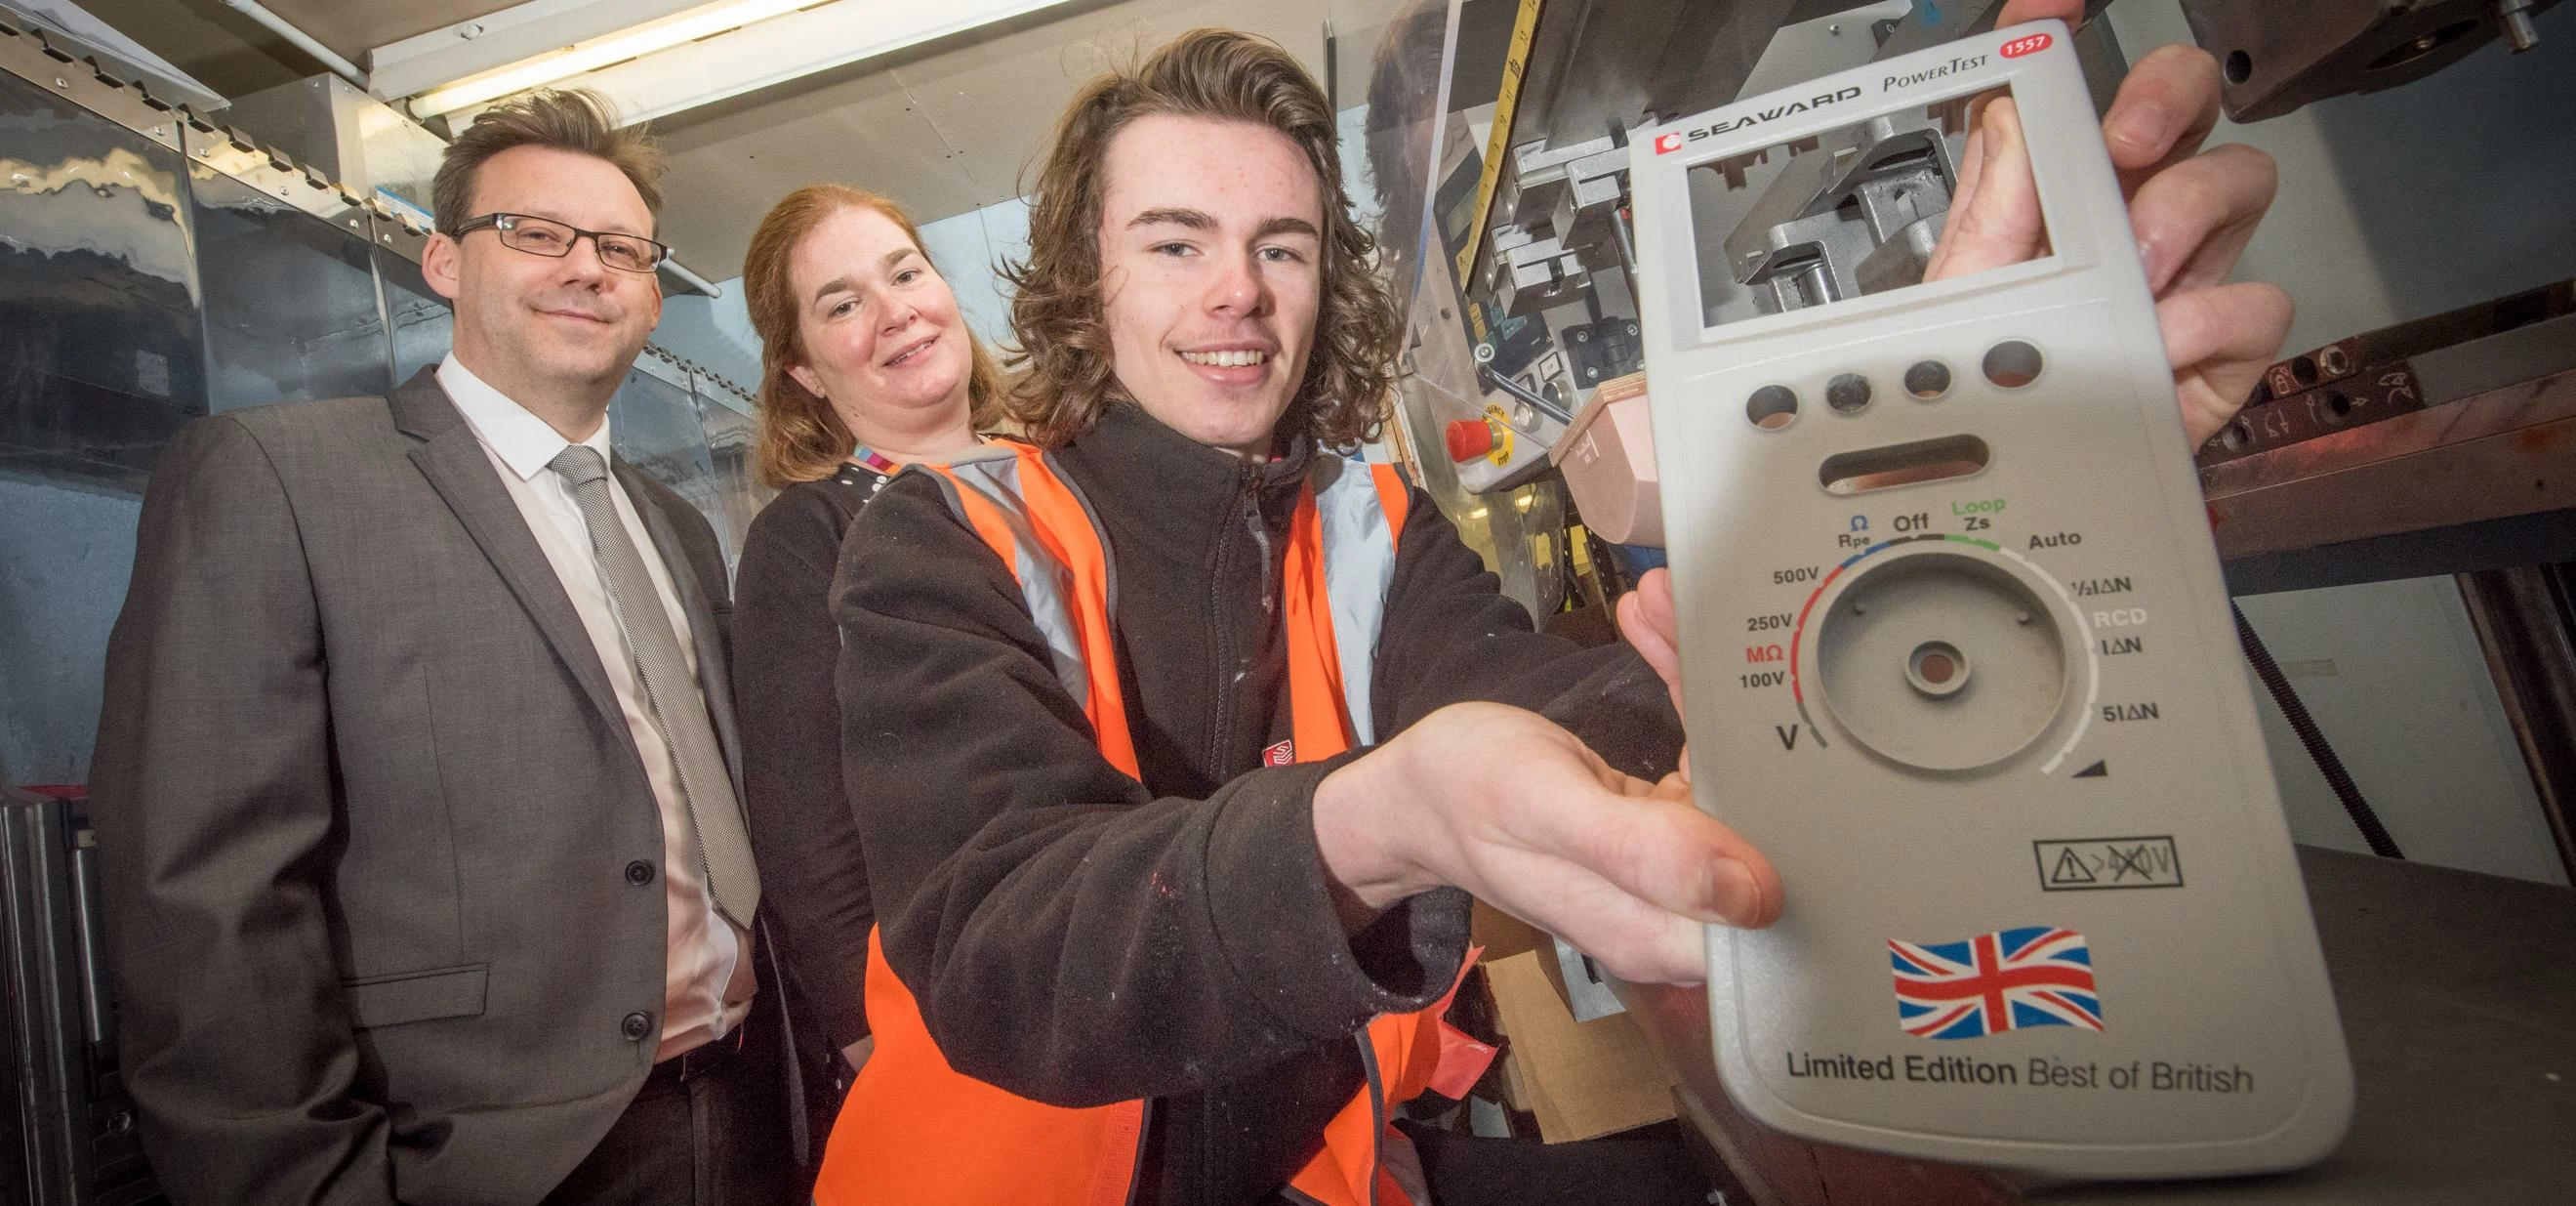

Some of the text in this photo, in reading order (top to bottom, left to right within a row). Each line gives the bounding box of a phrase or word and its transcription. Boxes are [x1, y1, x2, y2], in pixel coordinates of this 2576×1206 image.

[2006, 36, 2047, 56] 1557
[1688, 86, 1861, 143] SEAWARD
[1951, 499, 2006, 516] Loop
[1893, 513, 1929, 532] Off
[2028, 531, 2082, 550] Auto
[1773, 566, 1820, 584] 500V
[1746, 613, 1793, 632] 250V
[2093, 607, 2147, 628] RCD
[1740, 671, 1785, 688] 100V
[1776, 724, 1798, 751] V
[1786, 1052, 2254, 1093] Limited Edition Best of British
